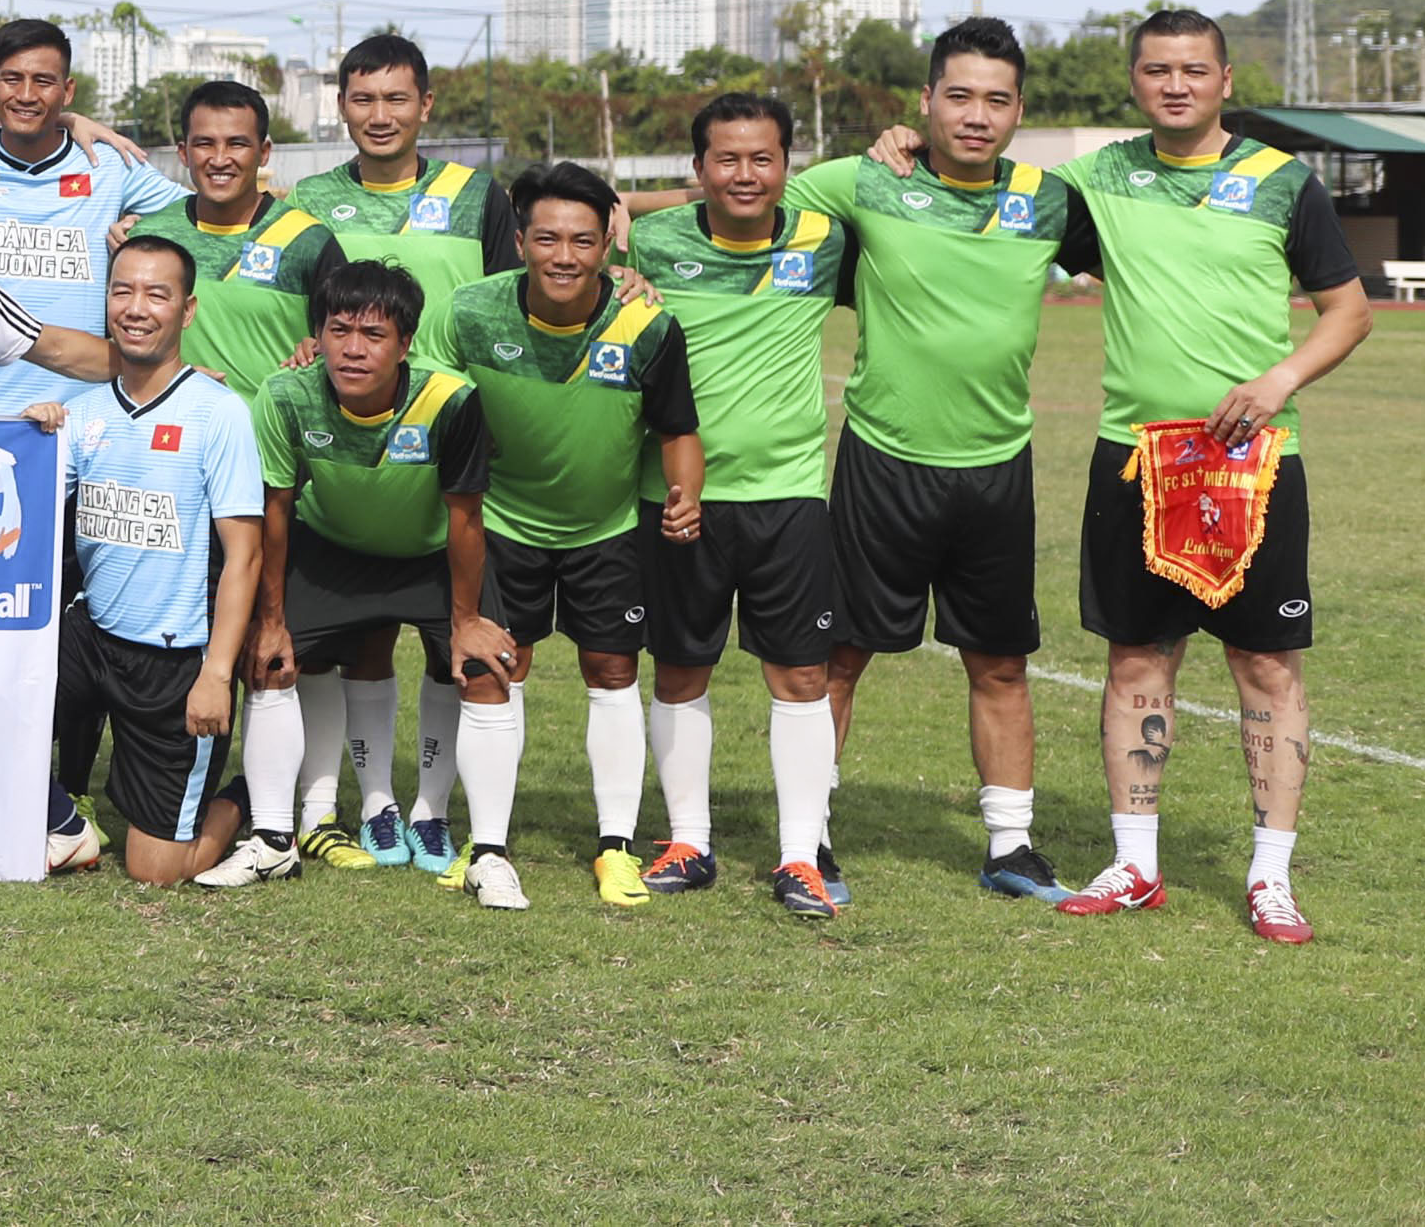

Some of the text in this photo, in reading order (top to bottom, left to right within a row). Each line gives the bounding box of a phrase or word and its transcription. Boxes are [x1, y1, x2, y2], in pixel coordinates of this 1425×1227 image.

[56, 229, 86, 253] SA
[61, 256, 90, 281] SA
[80, 481, 174, 520] HOÀNG SA
[147, 523, 180, 550] SA
[1133, 694, 1147, 709] D
[351, 739, 369, 768] mitre
[423, 737, 440, 768] mitre
